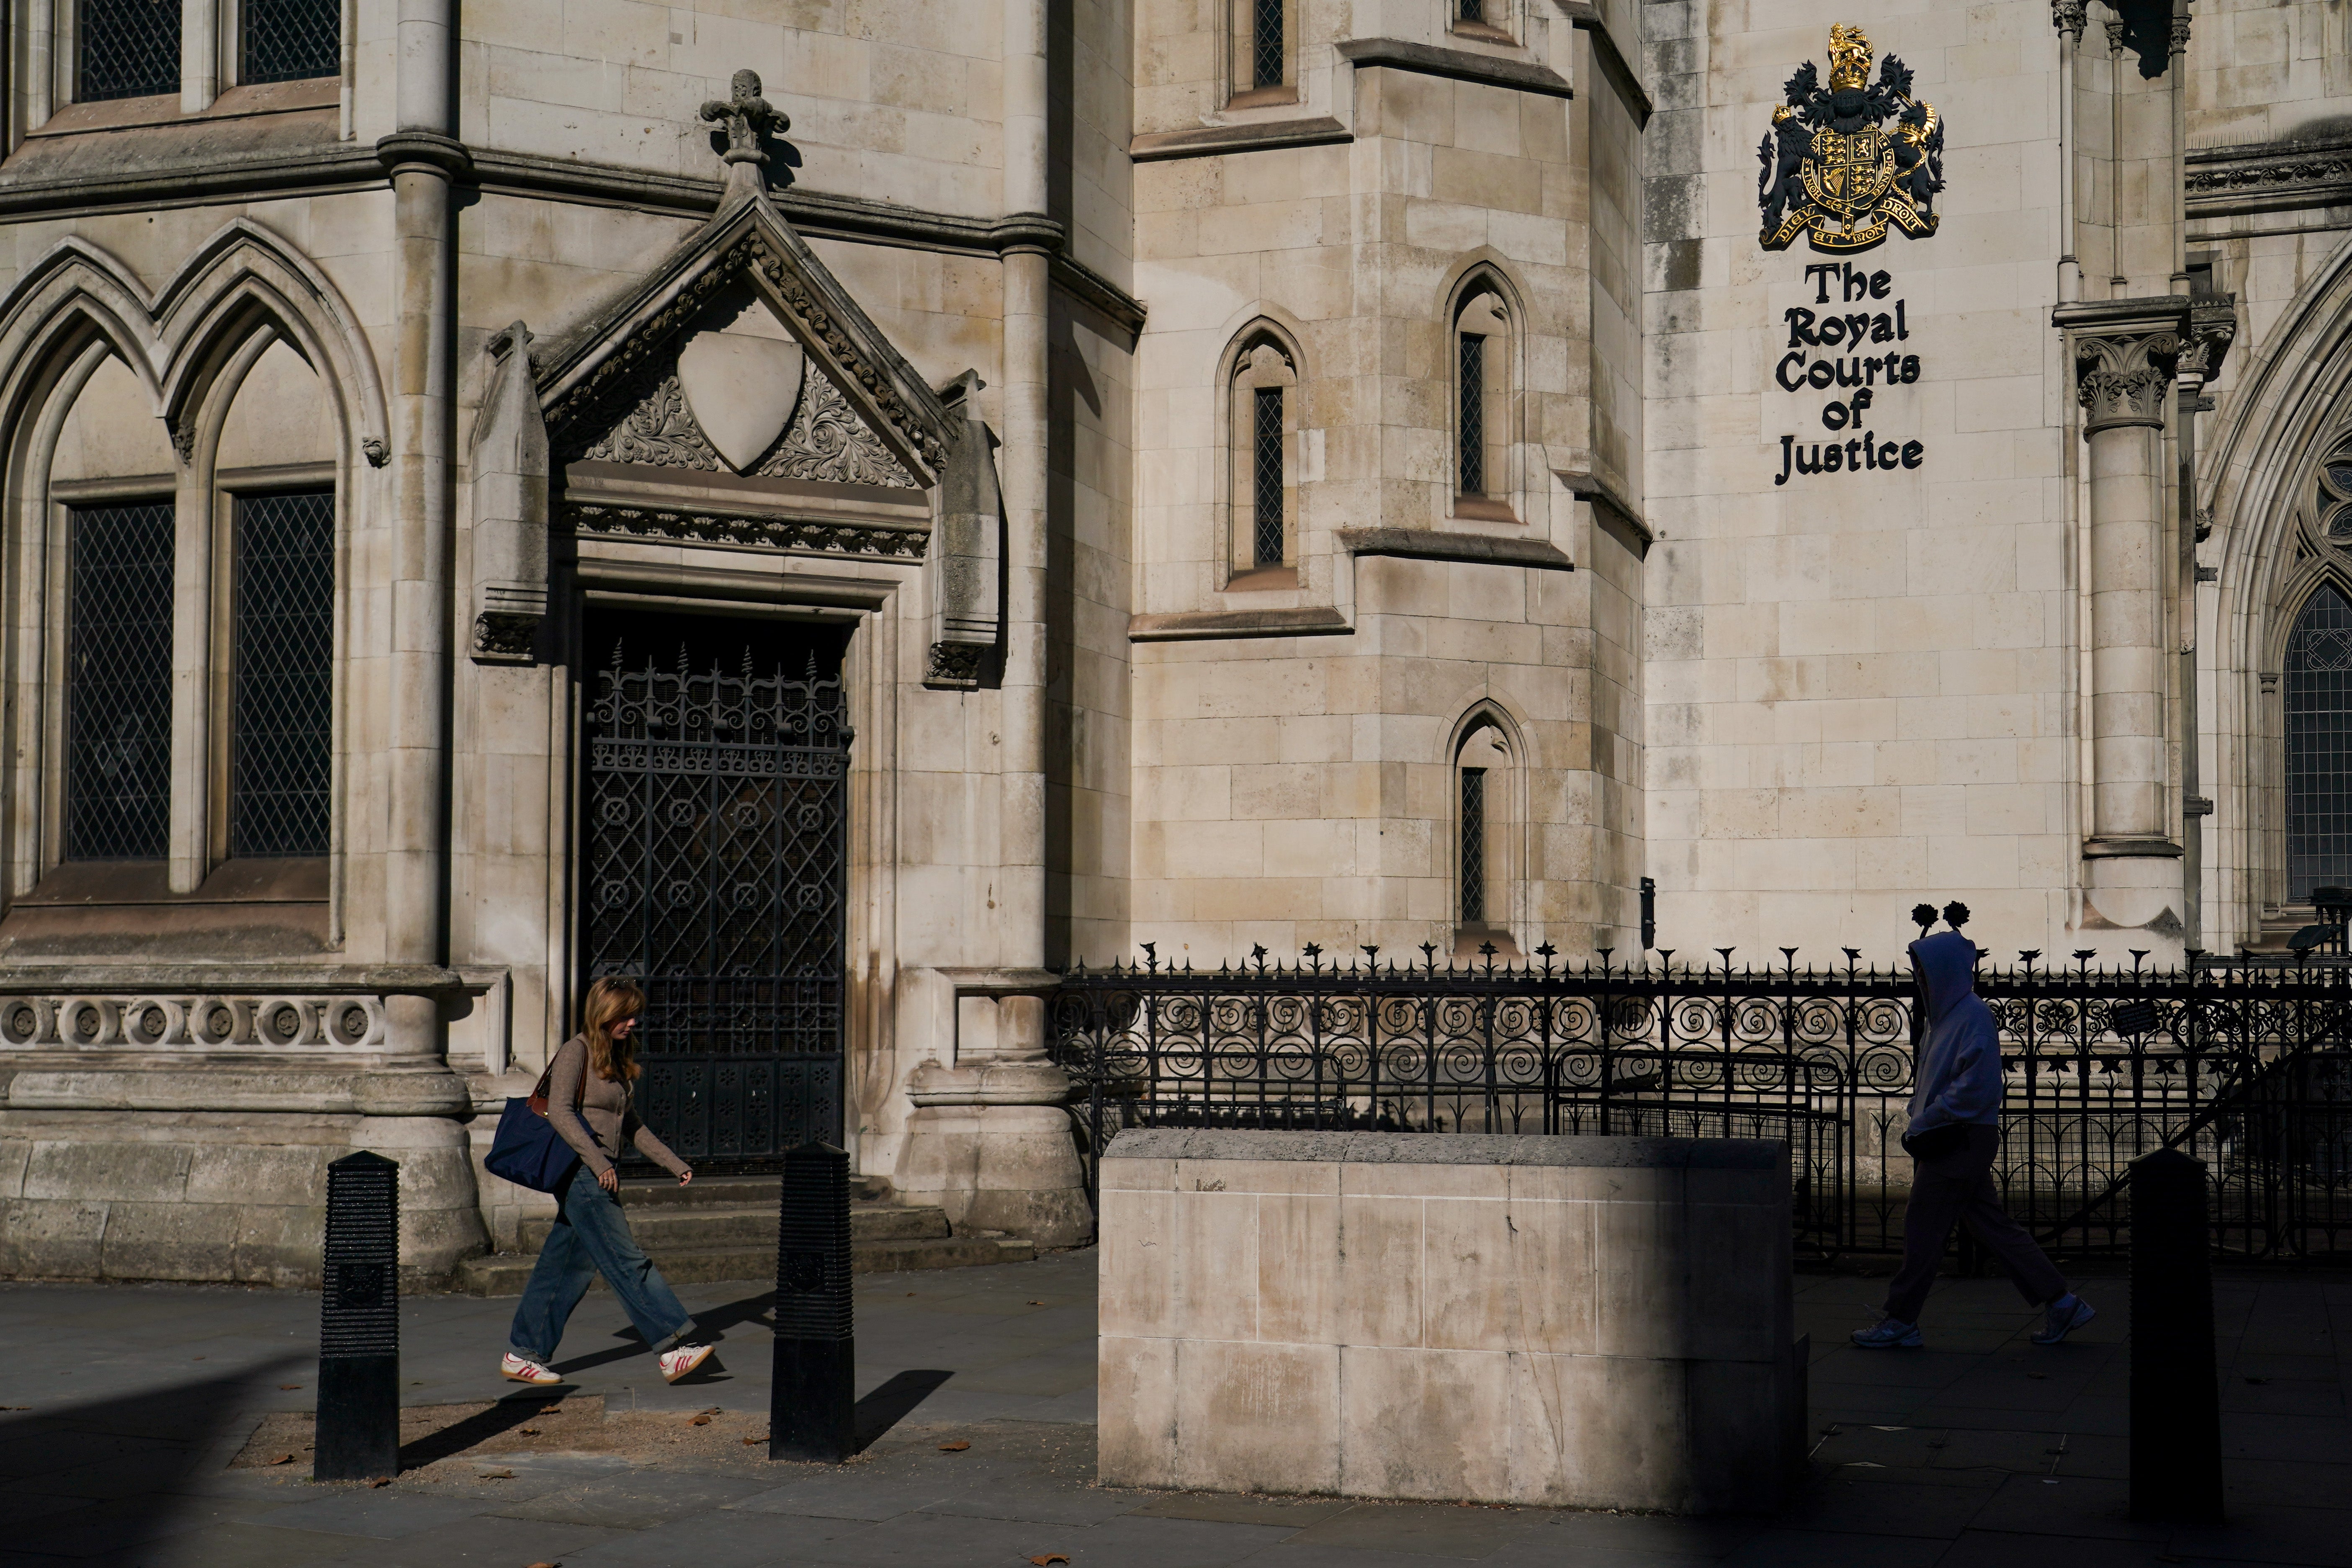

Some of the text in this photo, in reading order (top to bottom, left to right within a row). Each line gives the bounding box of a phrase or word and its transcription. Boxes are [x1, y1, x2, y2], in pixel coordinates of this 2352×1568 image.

[1804, 173, 1822, 200] HONI
[1814, 232, 1838, 244] ET
[1853, 223, 1886, 243] MON
[1880, 199, 1921, 230] DROIT
[1804, 261, 1891, 304] The
[1784, 299, 1909, 353] Royal
[1776, 350, 1921, 392] Courts
[1822, 387, 1873, 431] of
[1774, 430, 1924, 486] Justice
